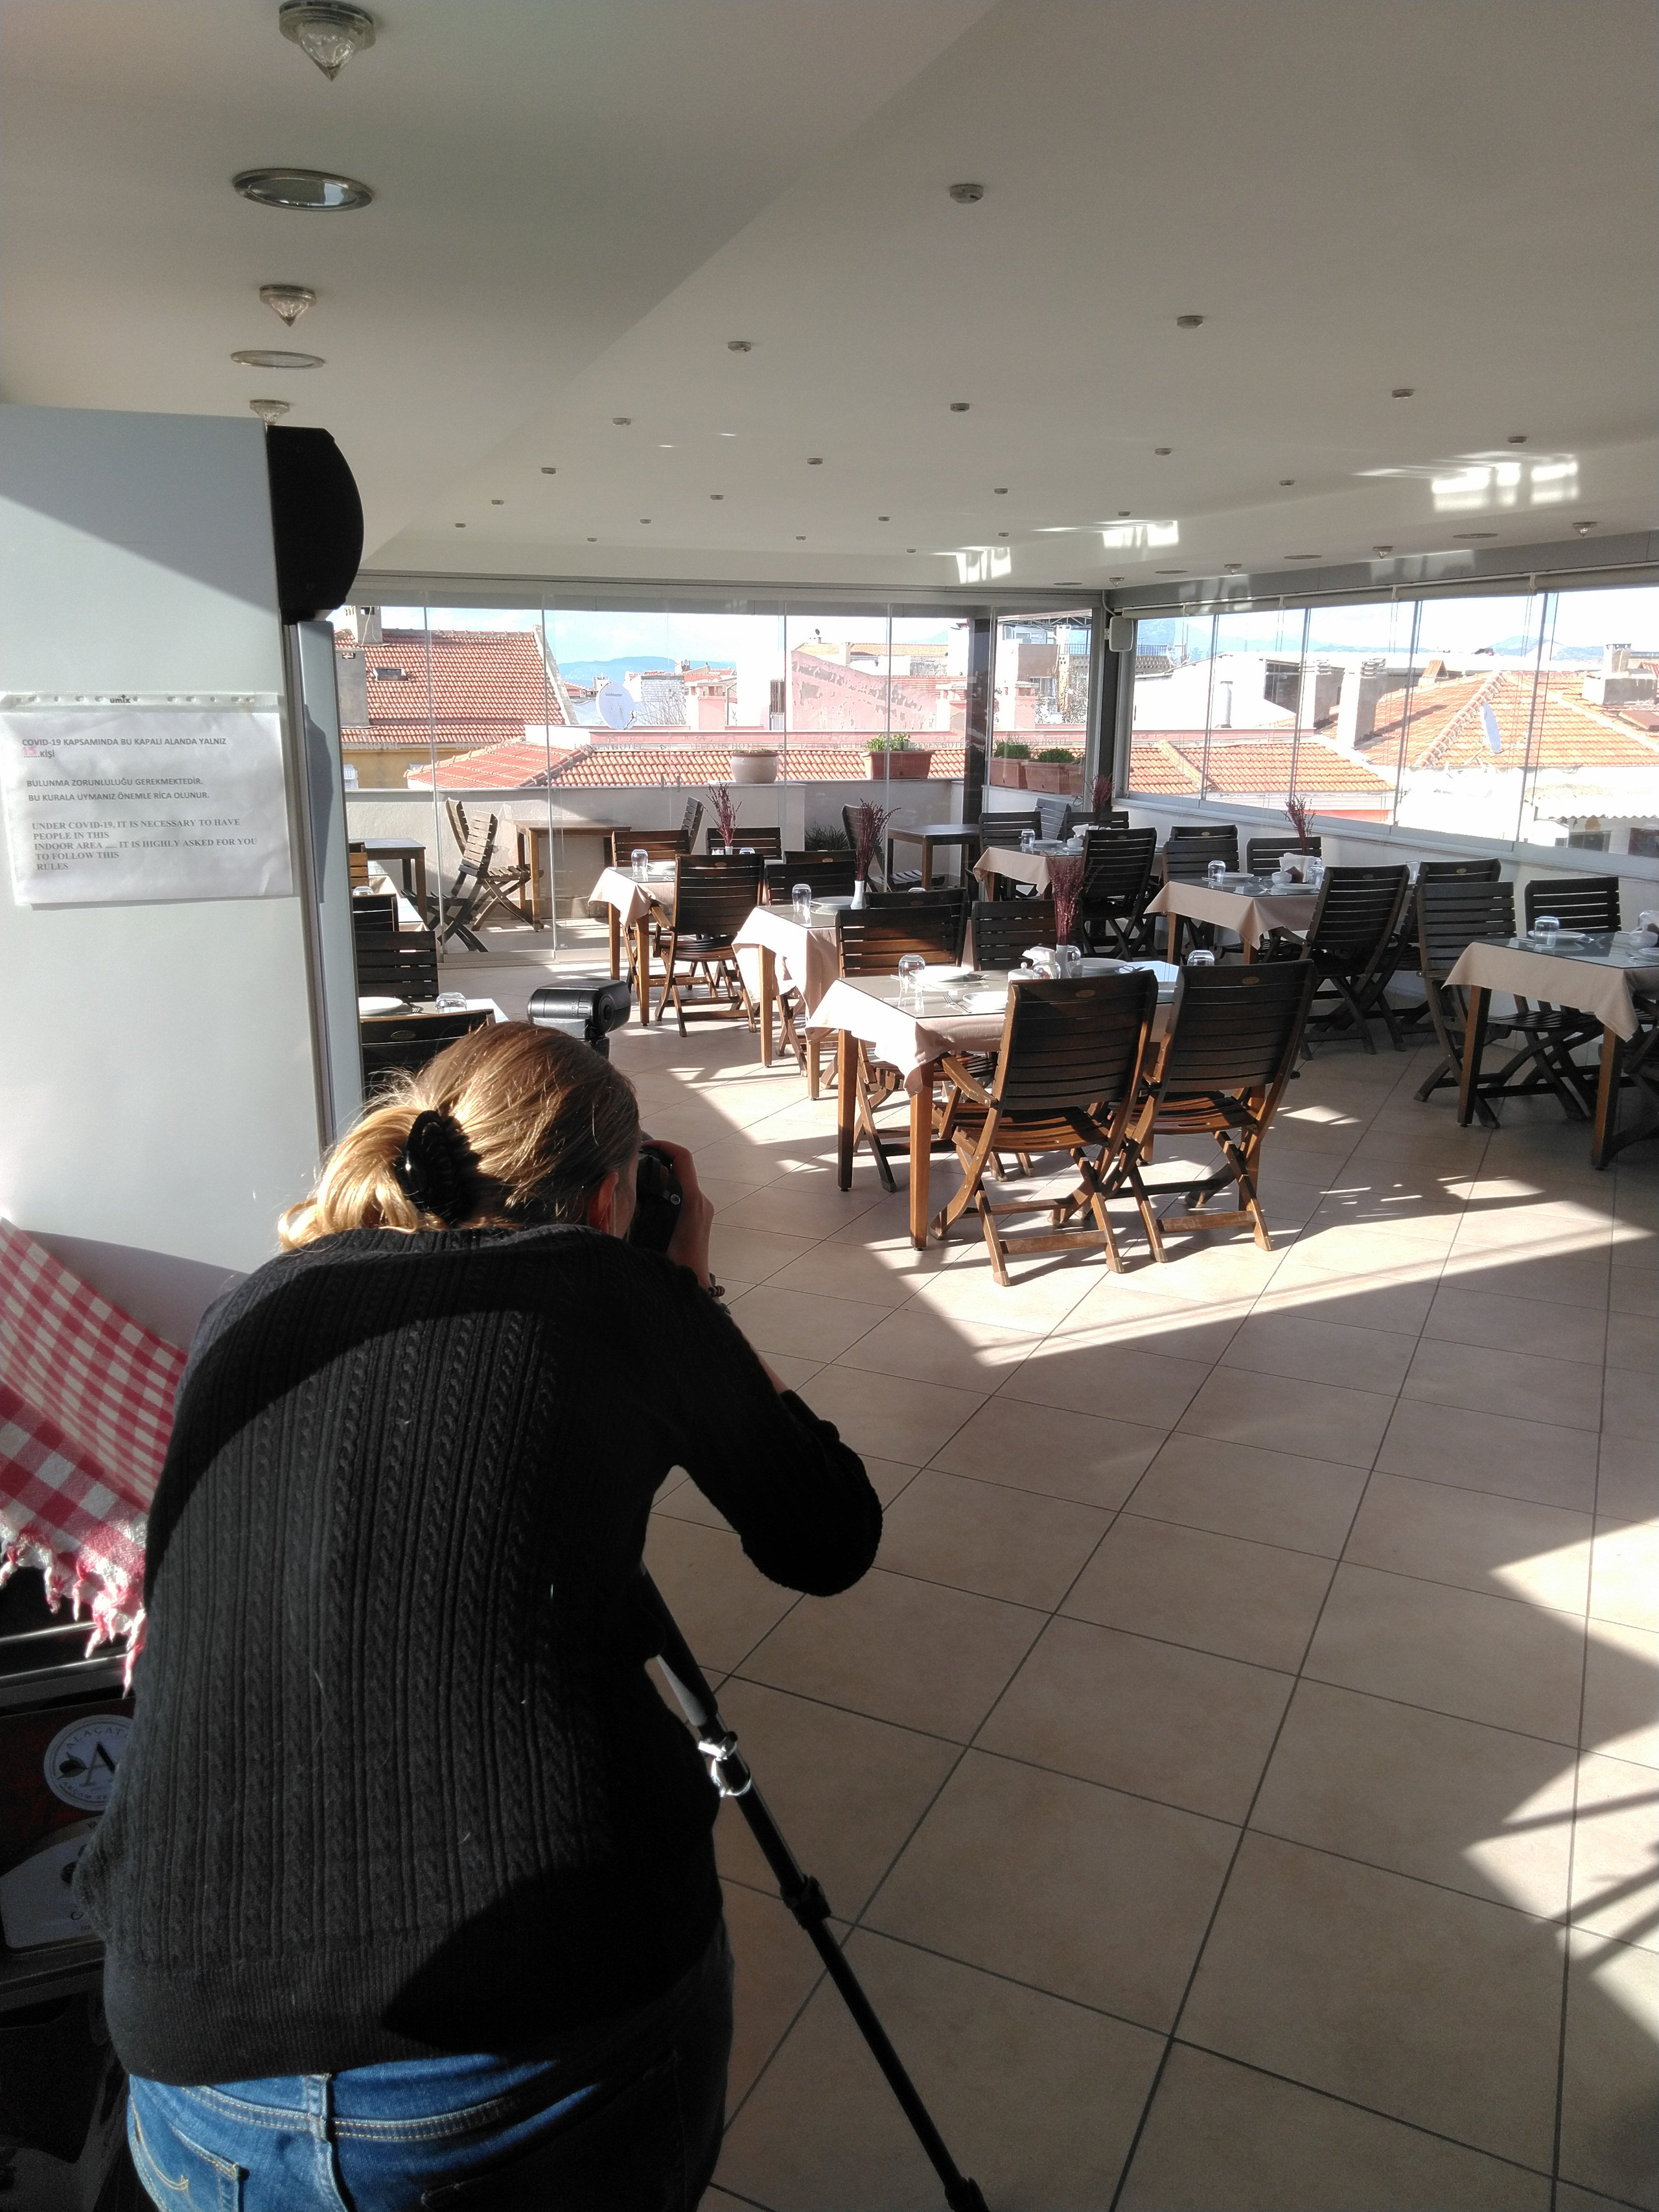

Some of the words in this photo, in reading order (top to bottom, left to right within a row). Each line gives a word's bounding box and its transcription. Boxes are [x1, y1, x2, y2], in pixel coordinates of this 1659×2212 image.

[110, 694, 131, 704] umix
[72, 778, 133, 787] ZORUNLULUĞU
[135, 777, 203, 786] GEREKMEKTEDİR.
[117, 791, 152, 800] ÖNEMLE
[154, 791, 172, 800] RİCA
[32, 822, 66, 830] UNDER
[68, 821, 116, 830] COVID-19,
[141, 819, 196, 828] NECESSARY
[33, 832, 72, 841] PEOPLE
[87, 831, 110, 839] THIS
[52, 852, 94, 860] FOLLOW
[37, 863, 69, 871] RULES
